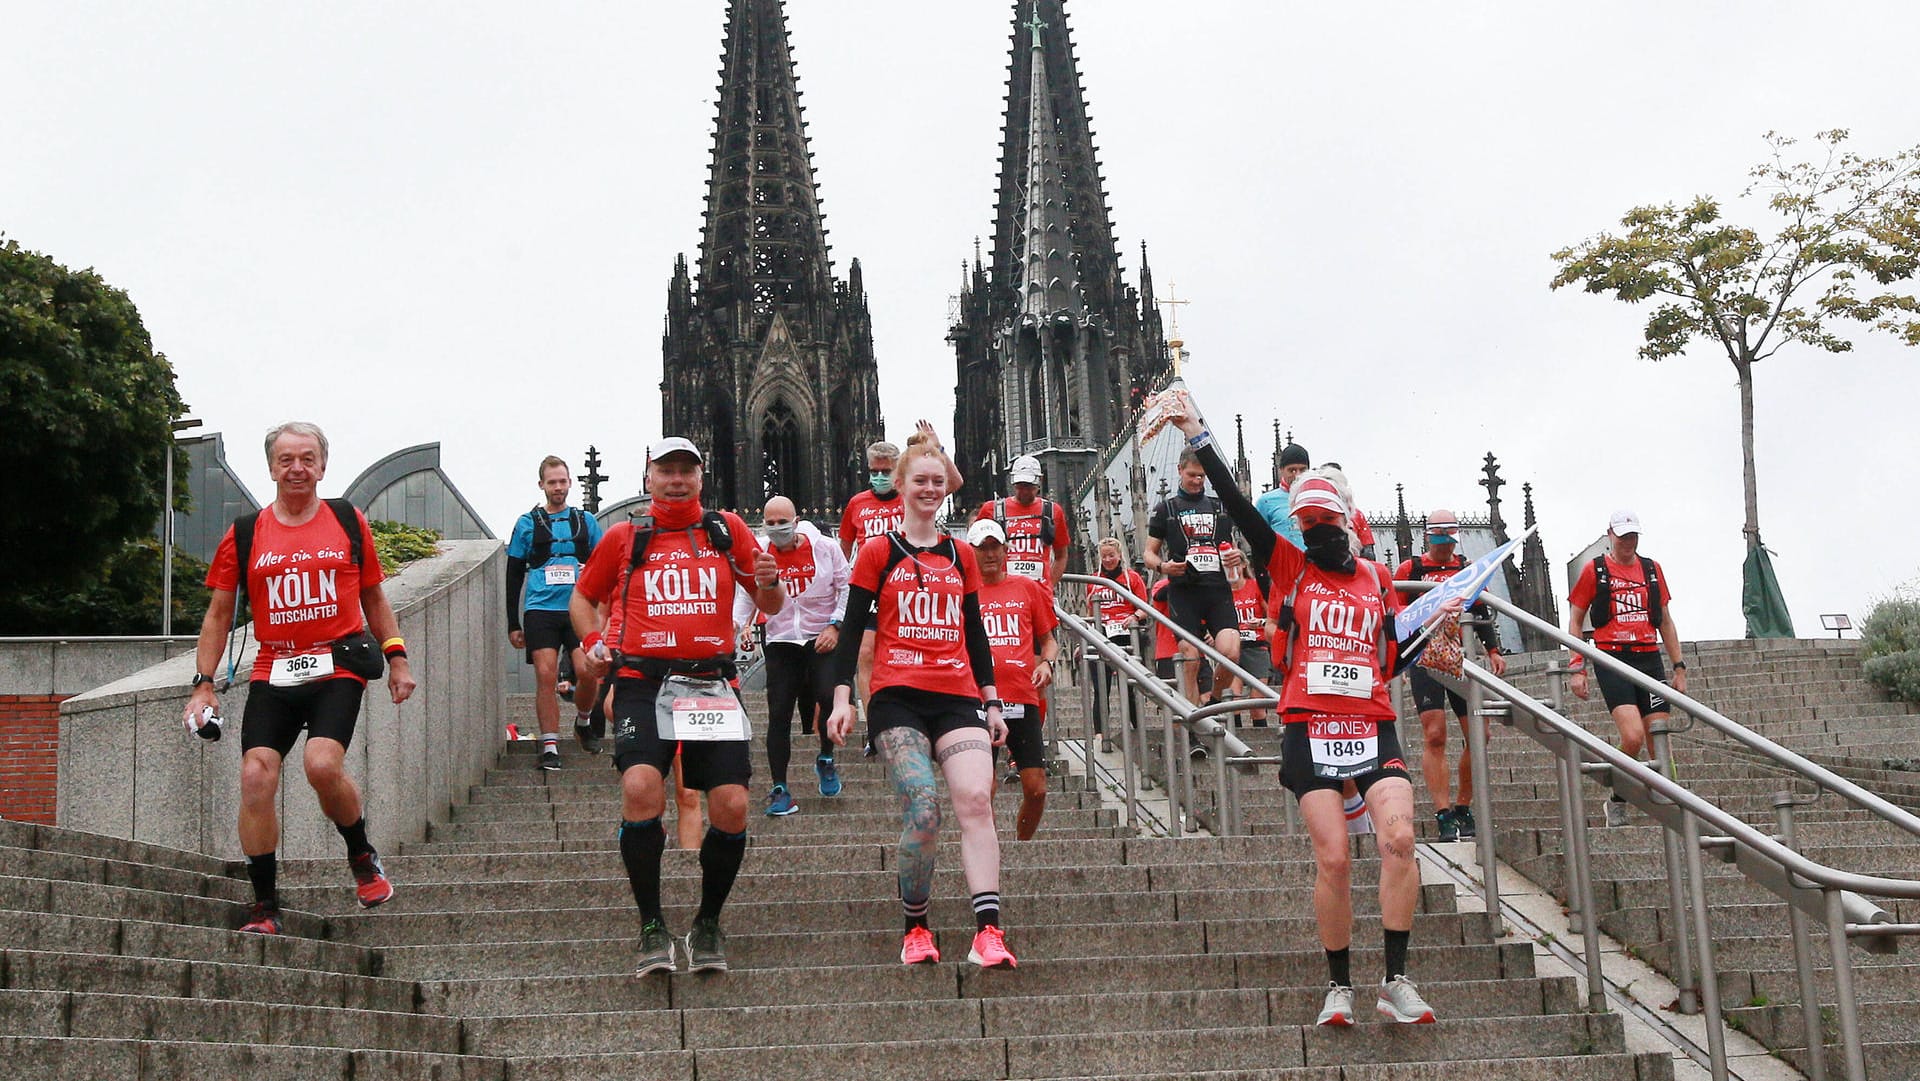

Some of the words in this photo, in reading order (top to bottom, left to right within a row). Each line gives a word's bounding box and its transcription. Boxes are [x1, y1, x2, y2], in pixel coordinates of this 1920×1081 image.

[254, 551, 286, 569] Mer
[291, 549, 313, 562] sin
[317, 547, 345, 559] eins
[649, 553, 665, 561] er
[670, 549, 690, 561] sin
[1193, 555, 1213, 563] 9703
[1014, 562, 1036, 571] 2209
[643, 563, 717, 602] KÖLN
[889, 567, 917, 583] Mer
[922, 570, 941, 582] sin
[265, 567, 337, 609] KÖLN
[648, 602, 717, 617] BOTSCHAFTER
[898, 586, 960, 626] KÖLN
[269, 604, 338, 625] BOTSCHAFTER
[1309, 599, 1378, 643] KÖLN
[980, 612, 1019, 637] ÖLN
[898, 626, 960, 642] BOTSCHAFTER
[286, 657, 318, 672] 3662
[1323, 665, 1359, 680] F236
[688, 712, 724, 725] 3292
[1323, 741, 1365, 757] 1849
